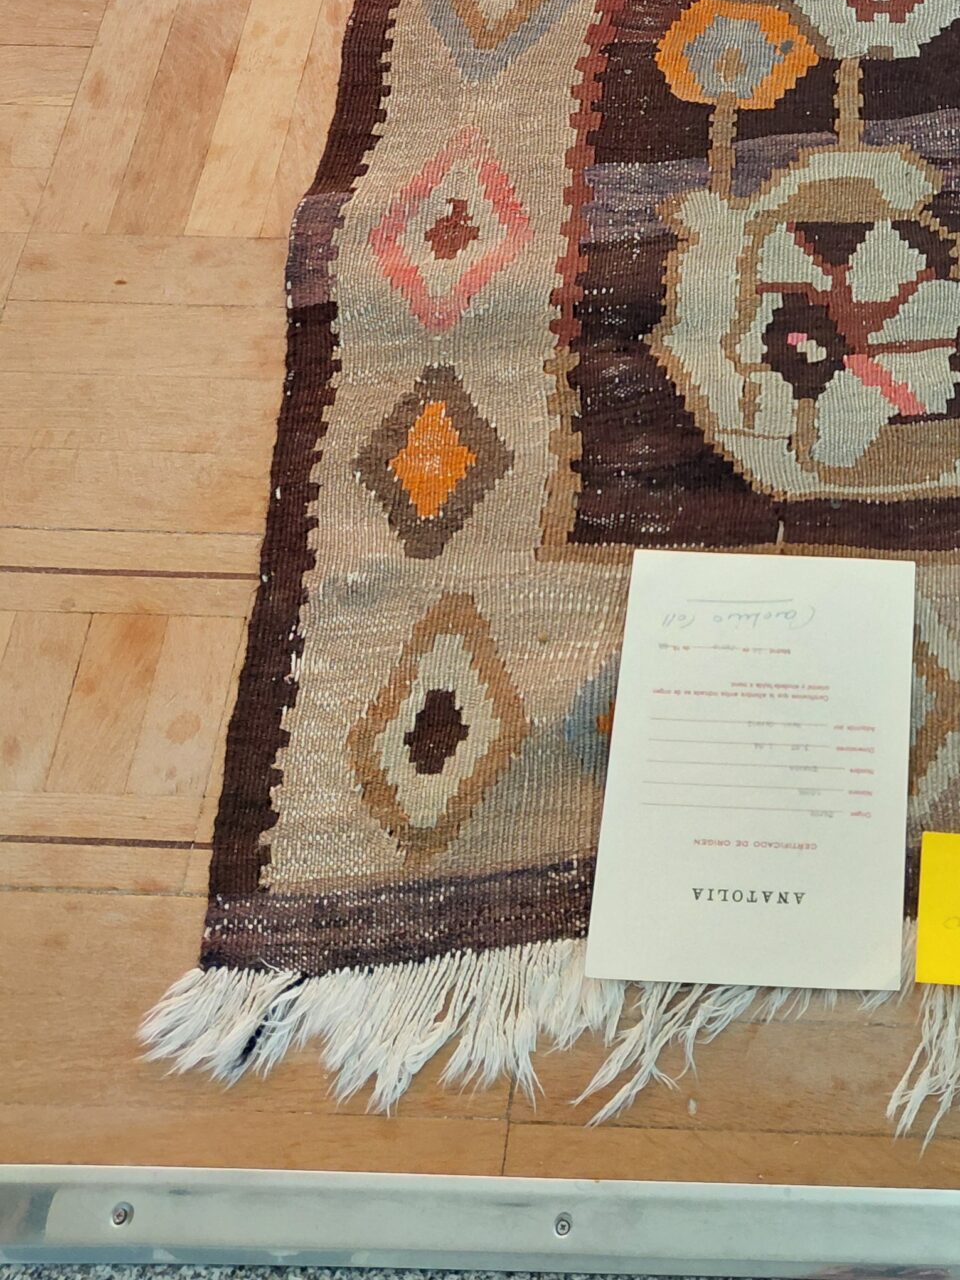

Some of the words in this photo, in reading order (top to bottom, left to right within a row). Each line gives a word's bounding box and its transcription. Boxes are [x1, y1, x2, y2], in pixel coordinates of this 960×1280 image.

[694, 839, 731, 847] ORIGEN
[753, 841, 817, 850] CERTIFICADO
[692, 888, 806, 905] ANATOLIA
